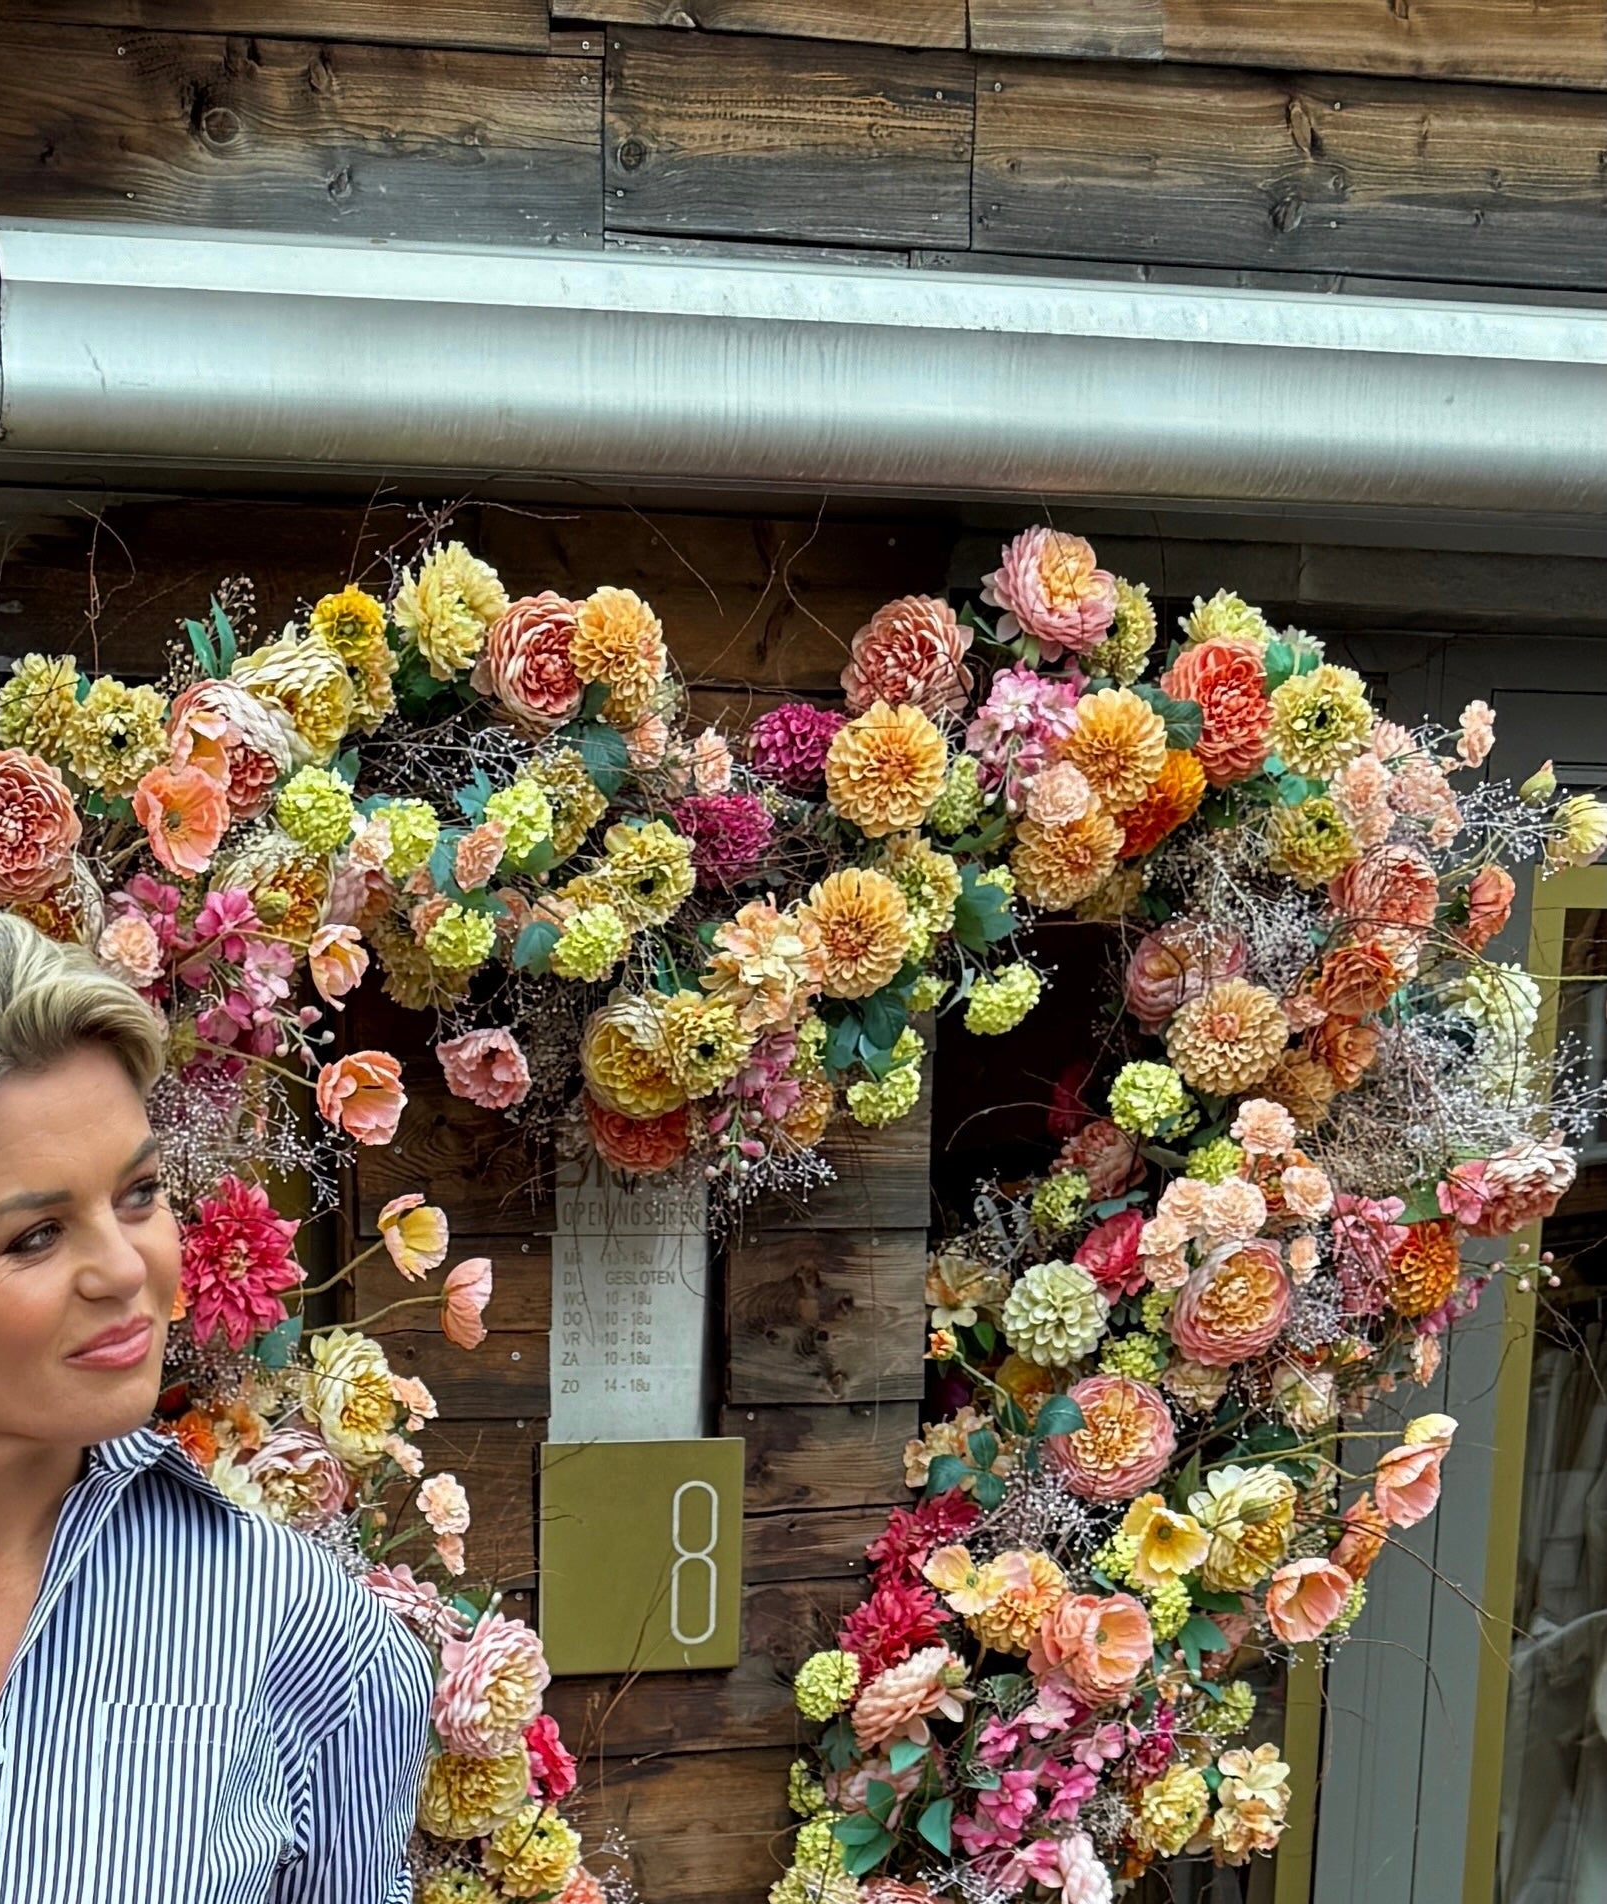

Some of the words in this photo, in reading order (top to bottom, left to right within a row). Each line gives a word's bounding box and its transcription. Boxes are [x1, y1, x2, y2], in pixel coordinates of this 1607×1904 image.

[563, 1271, 577, 1286] DI
[605, 1271, 675, 1286] GESLOTEN
[563, 1291, 586, 1306] WO
[605, 1291, 619, 1305] 10
[632, 1290, 652, 1305] 18u
[562, 1311, 583, 1326] DO
[605, 1311, 619, 1325] 10
[632, 1311, 652, 1325] 18u
[562, 1331, 581, 1346] VR
[605, 1331, 619, 1345] 10
[631, 1331, 652, 1345] 18u
[561, 1351, 580, 1366] ZA
[604, 1351, 619, 1365] 10
[630, 1351, 651, 1365] 18u
[561, 1379, 580, 1393] ZO
[604, 1378, 618, 1392] 14
[630, 1378, 651, 1392] 18u
[670, 1480, 719, 1645] 8
